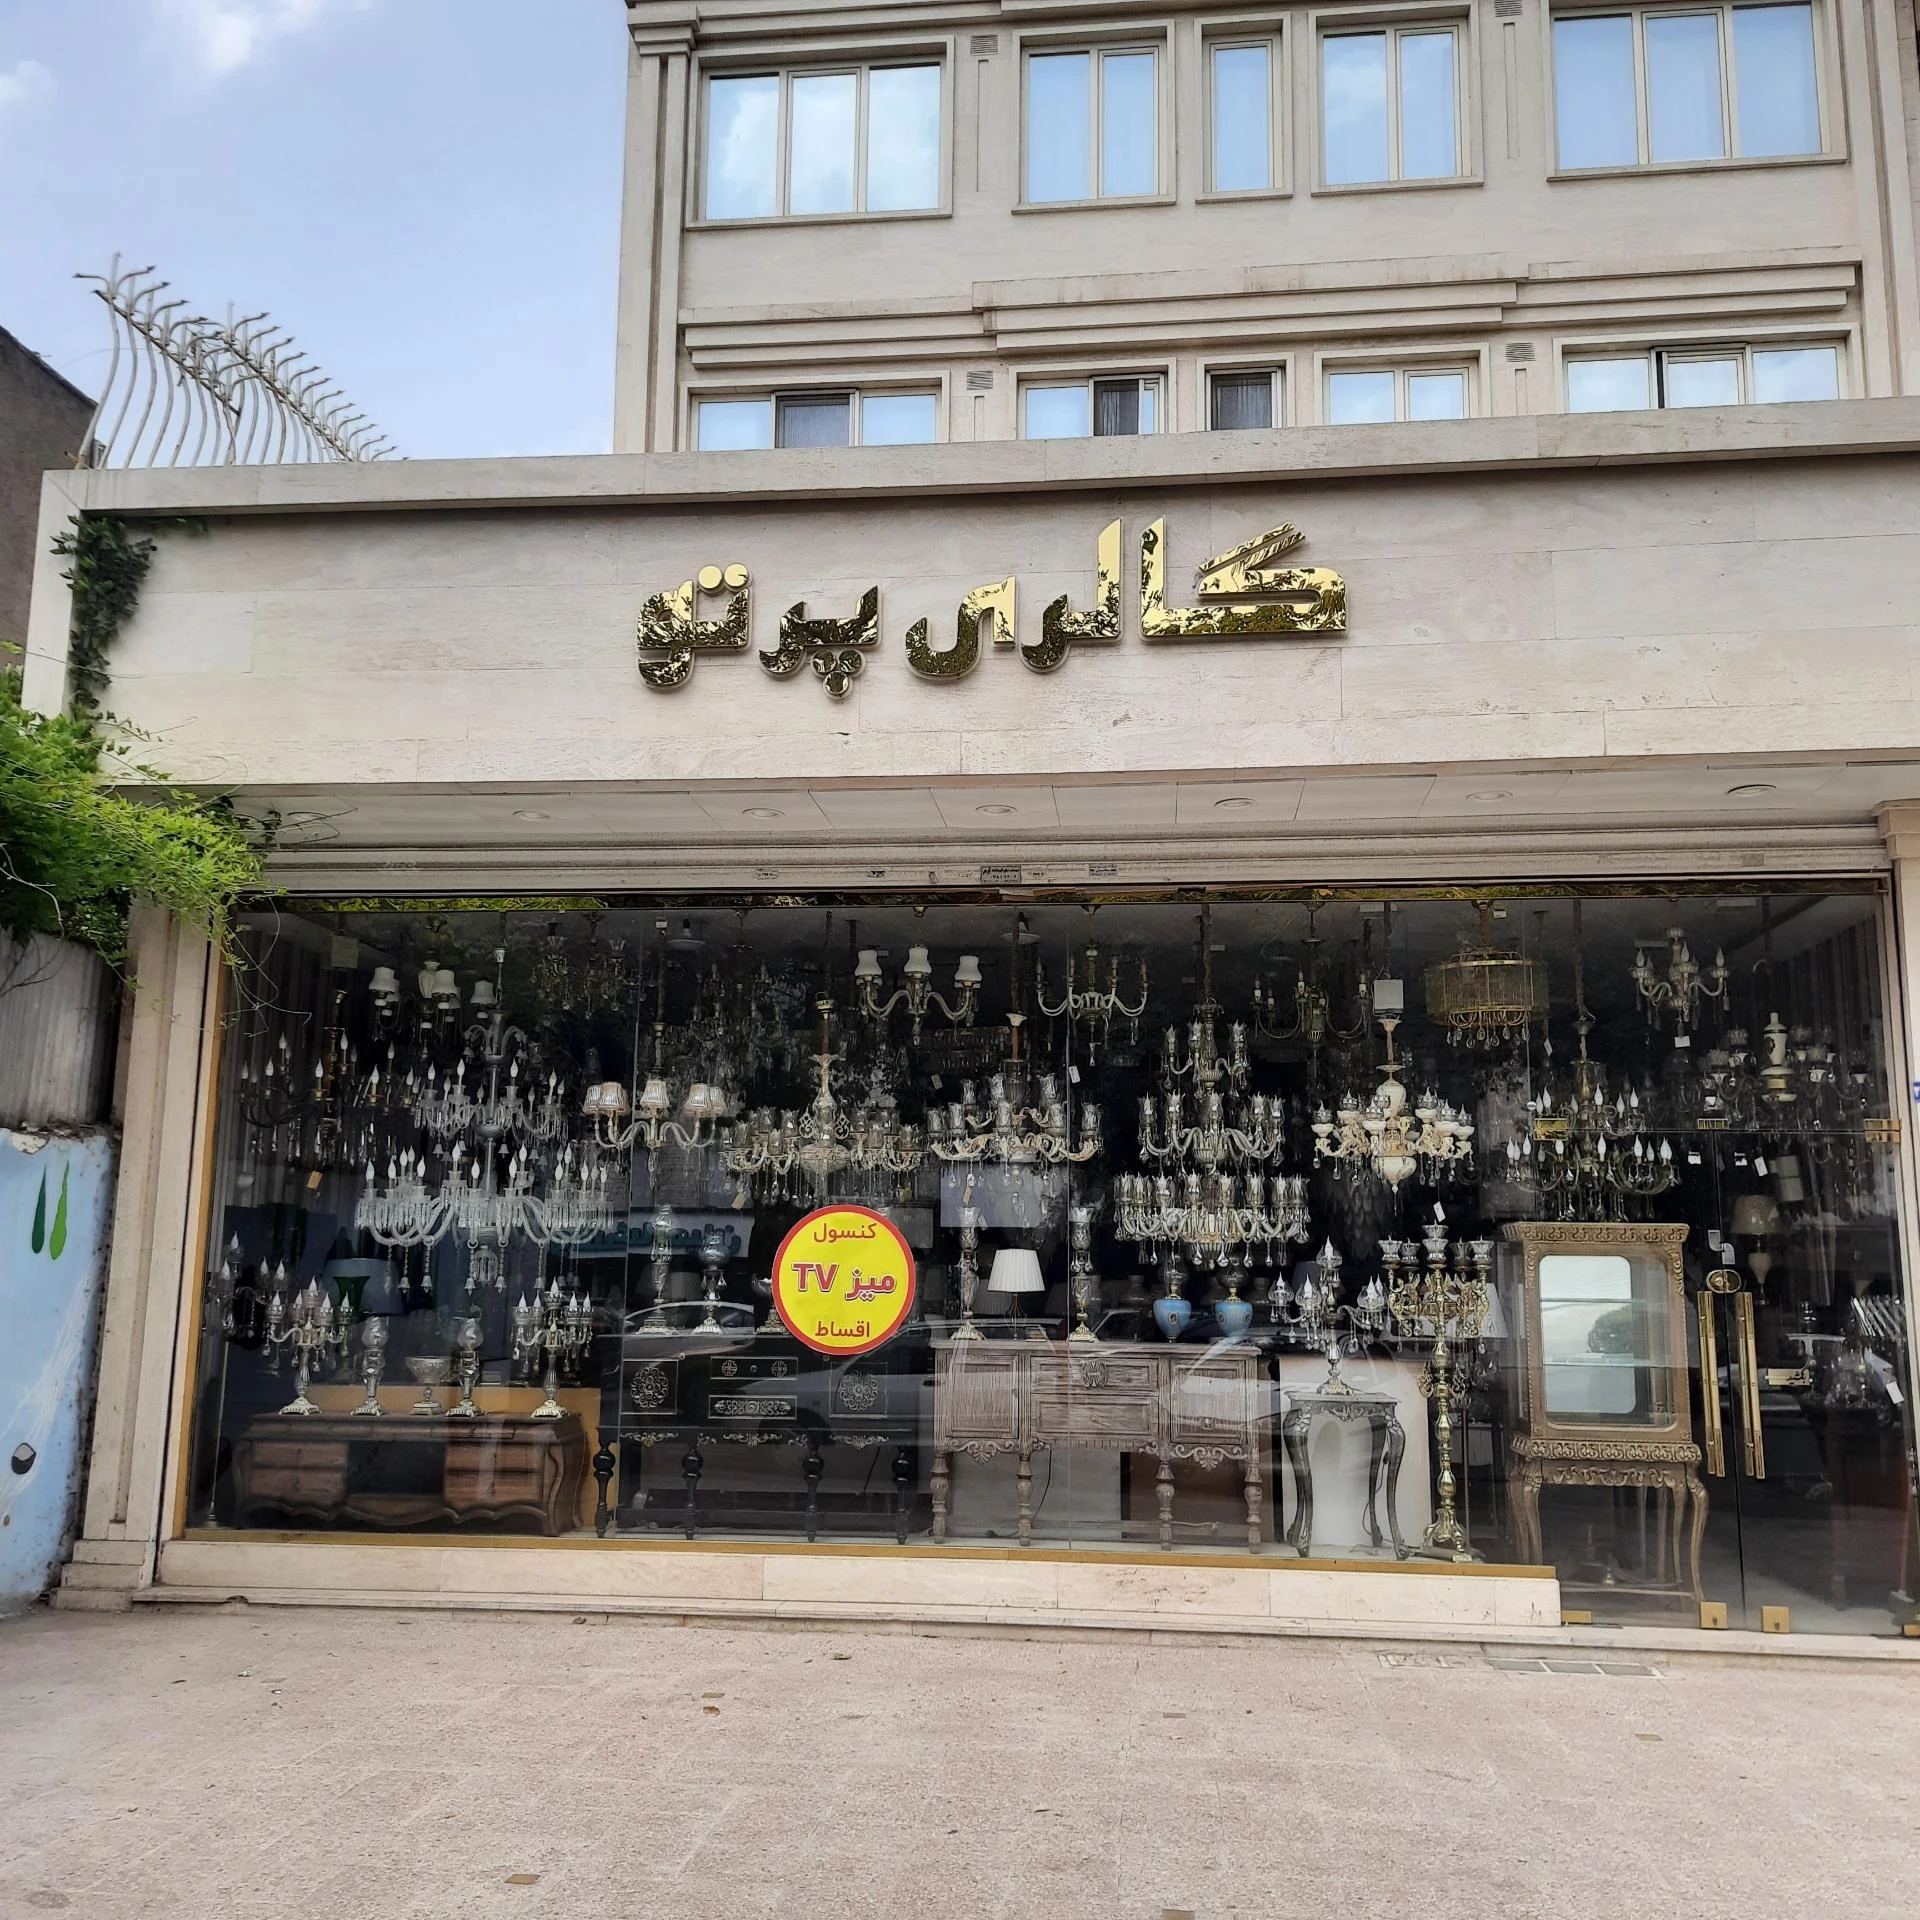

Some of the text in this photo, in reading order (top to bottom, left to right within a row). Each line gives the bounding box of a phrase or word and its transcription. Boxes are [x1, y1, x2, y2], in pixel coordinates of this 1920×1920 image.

[636, 562, 881, 698] پرتو
[813, 1222, 877, 1243] کنسول
[791, 1262, 897, 1301] میز TV
[814, 1320, 870, 1338] اقساط
